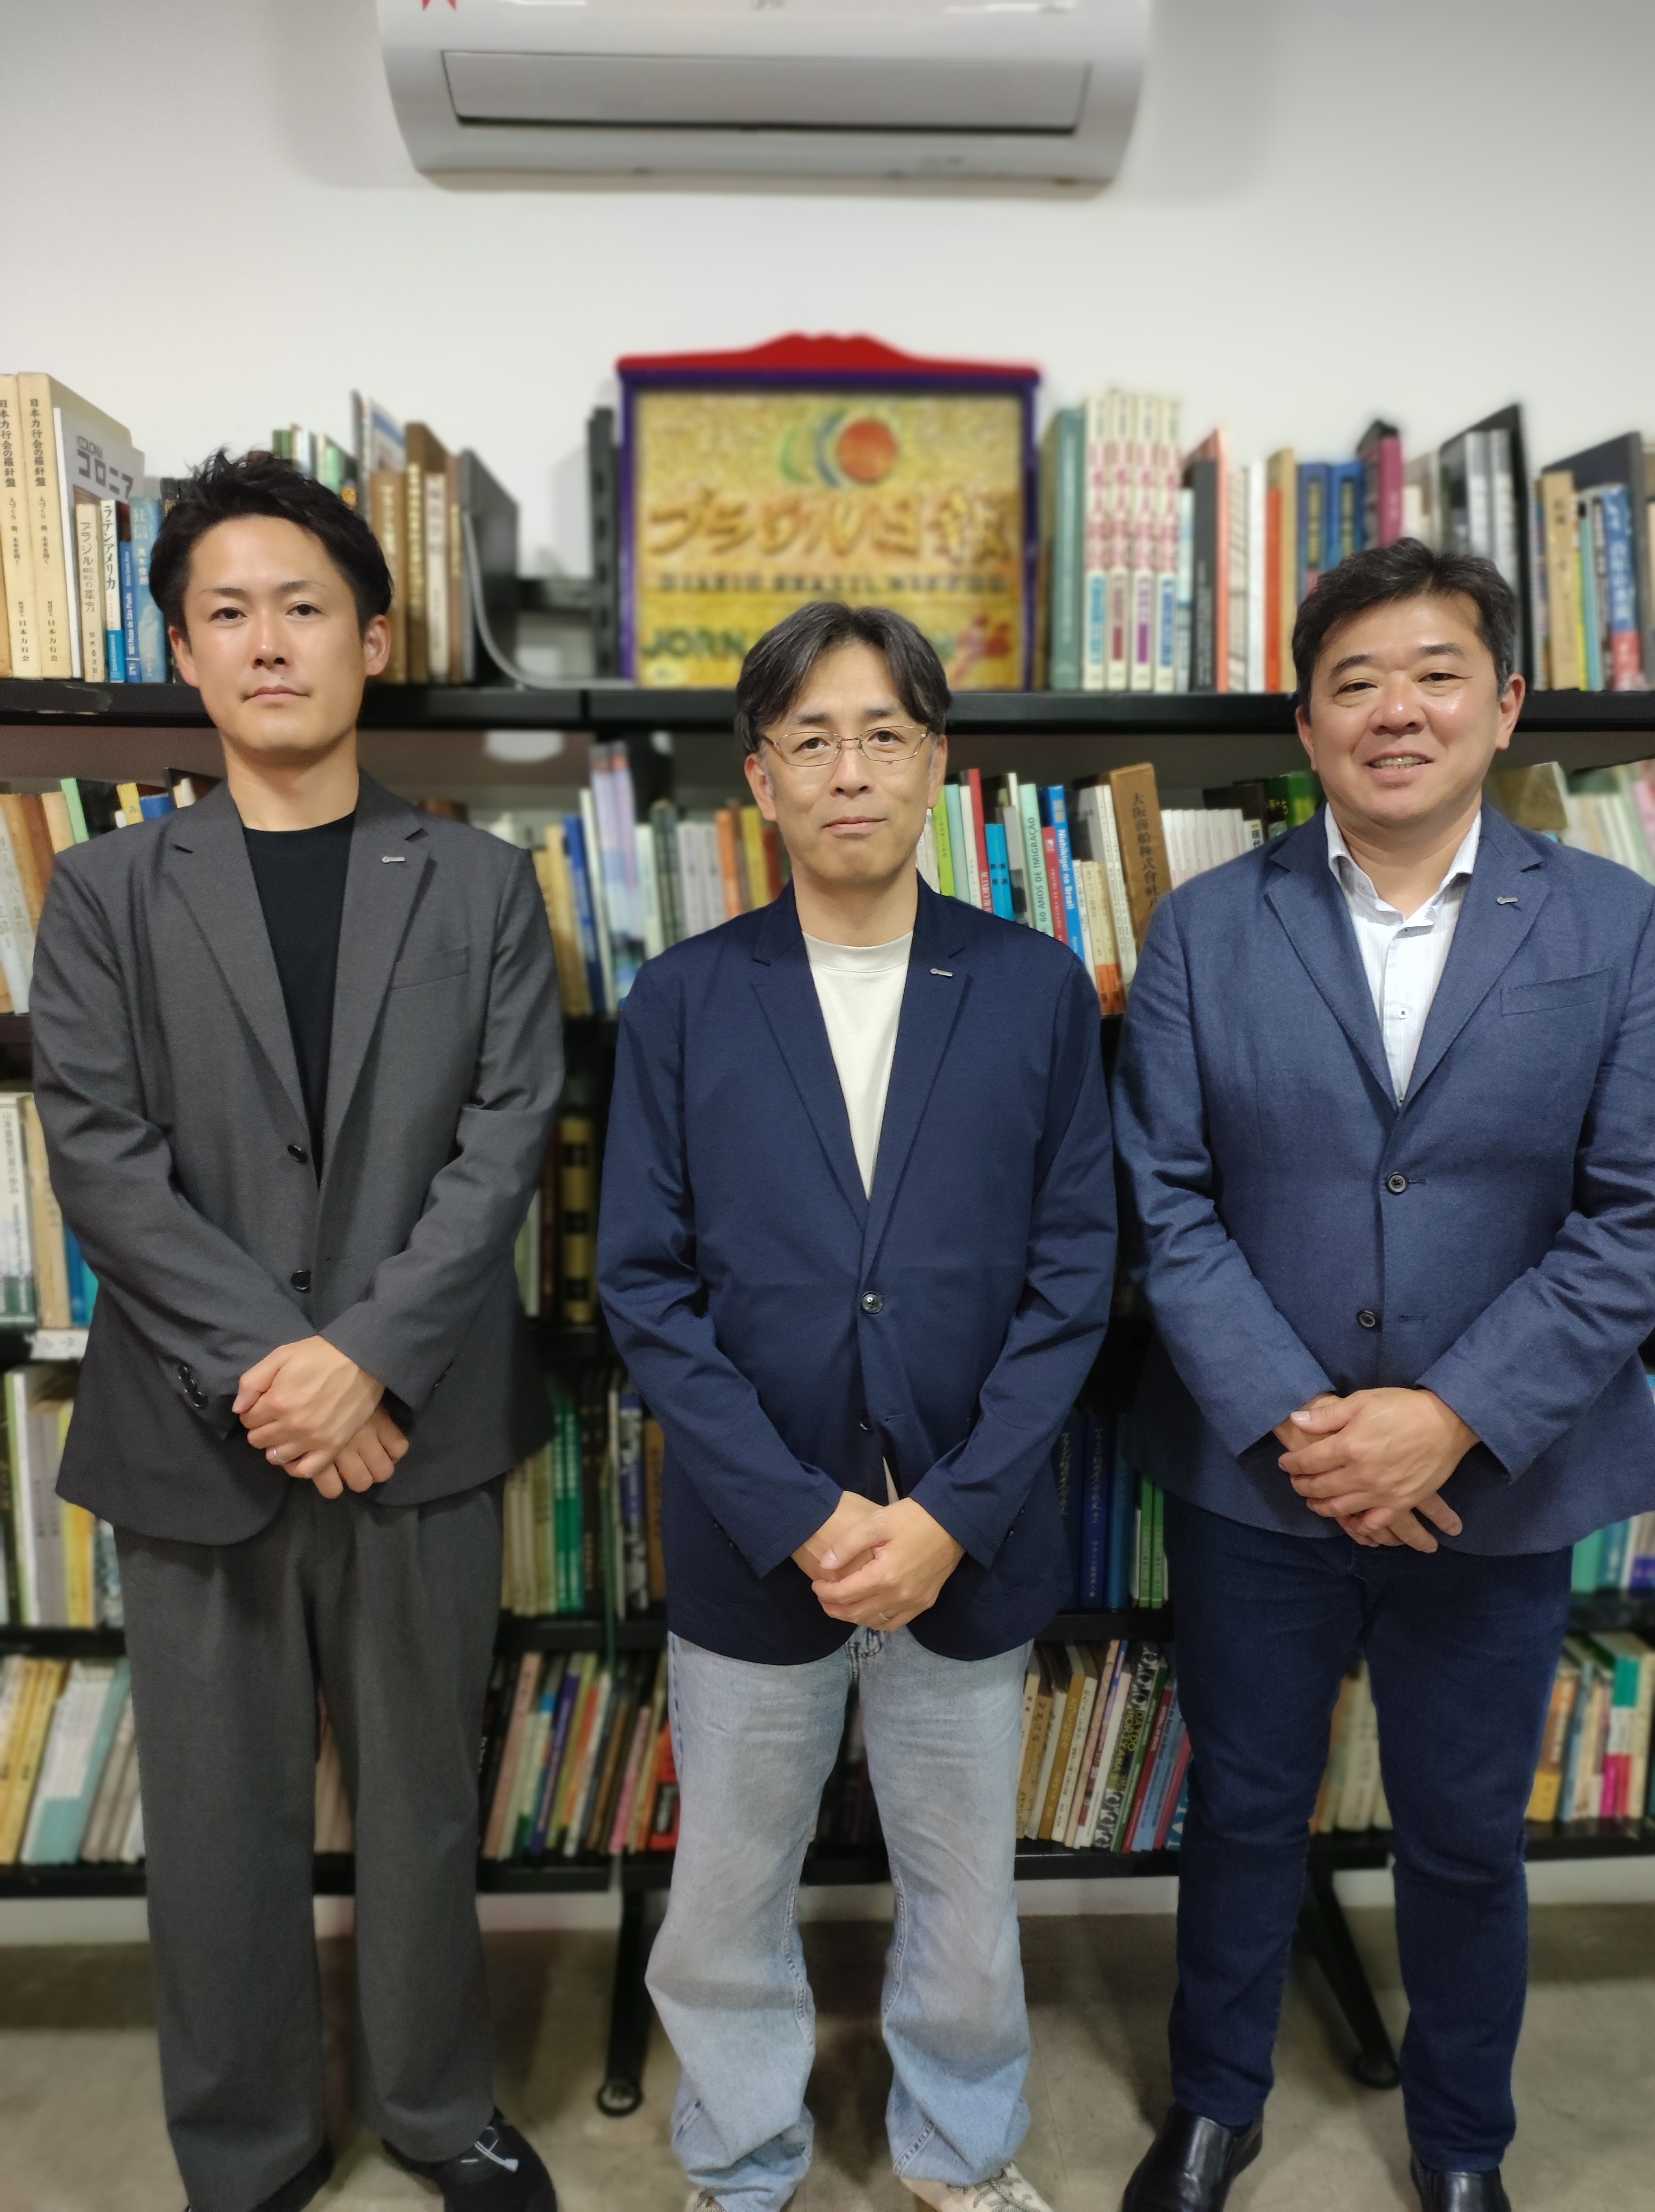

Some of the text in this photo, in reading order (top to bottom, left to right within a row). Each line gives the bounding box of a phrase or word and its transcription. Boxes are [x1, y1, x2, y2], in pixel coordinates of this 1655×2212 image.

[0, 399, 17, 487] 日本力行会の羅針盤
[30, 399, 47, 487] 日本力行会の羅針盤
[77, 448, 133, 499] コロニア
[102, 505, 115, 590] ラテンアメリカ
[642, 627, 749, 658] JORN
[1027, 817, 1041, 869] IMIGRAÇÃO
[1057, 829, 1071, 871] Nishikigoi
[1034, 870, 1042, 883] DE
[1036, 885, 1045, 909] ANOS
[1062, 873, 1070, 884] no
[1039, 912, 1047, 922] 60
[1064, 886, 1075, 910] Brasil
[1113, 1708, 1136, 1772] MORIYAMA
[1127, 1710, 1145, 1751] DAIDO
